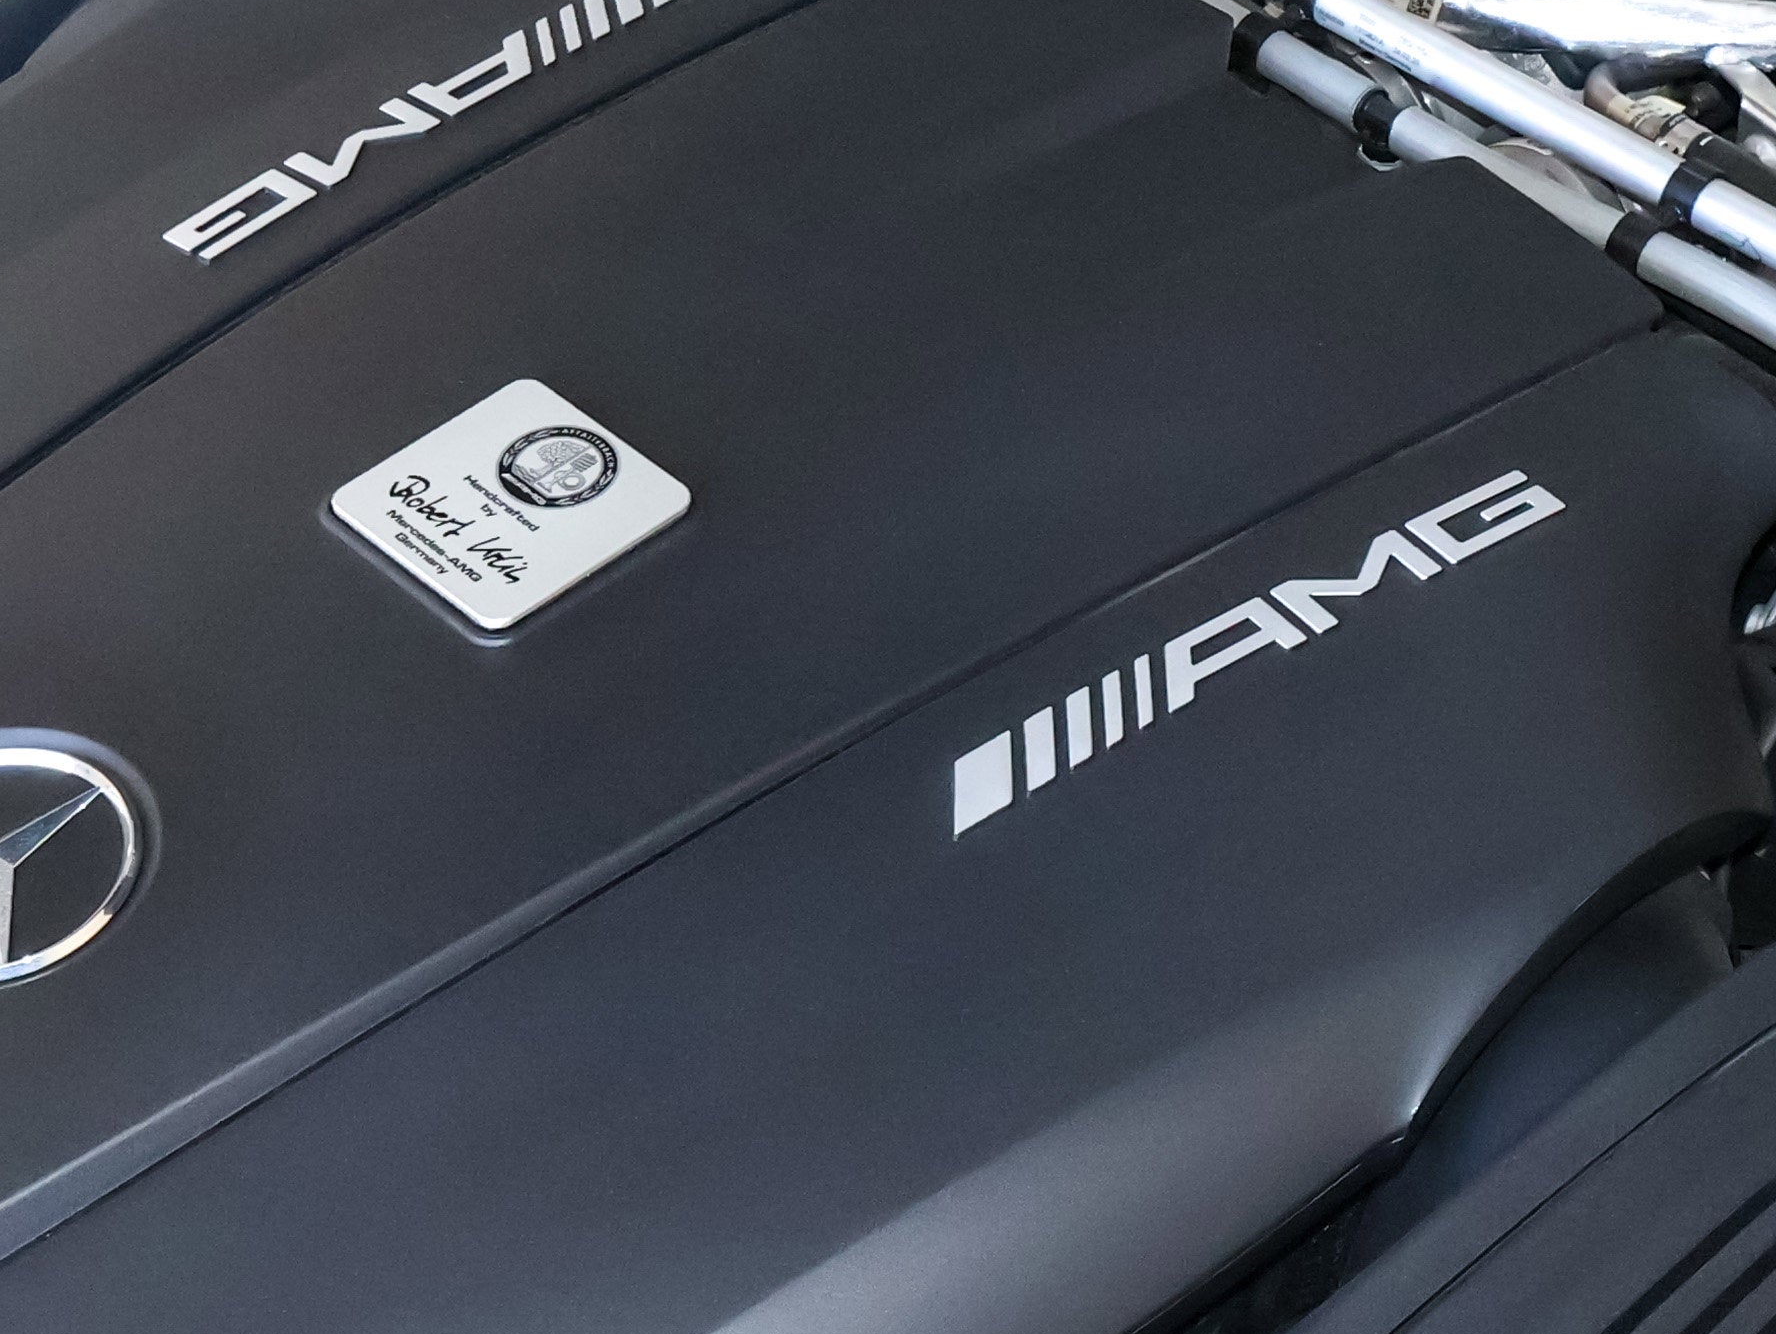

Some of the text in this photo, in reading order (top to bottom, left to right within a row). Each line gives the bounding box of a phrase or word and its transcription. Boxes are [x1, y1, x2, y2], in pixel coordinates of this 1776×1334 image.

[163, 29, 533, 264] AMG
[463, 474, 540, 532] Handcrafted
[480, 503, 498, 517] by
[386, 509, 483, 582] Mercedes-AMG
[394, 532, 449, 575] Germany
[1164, 469, 1567, 715] AMG
